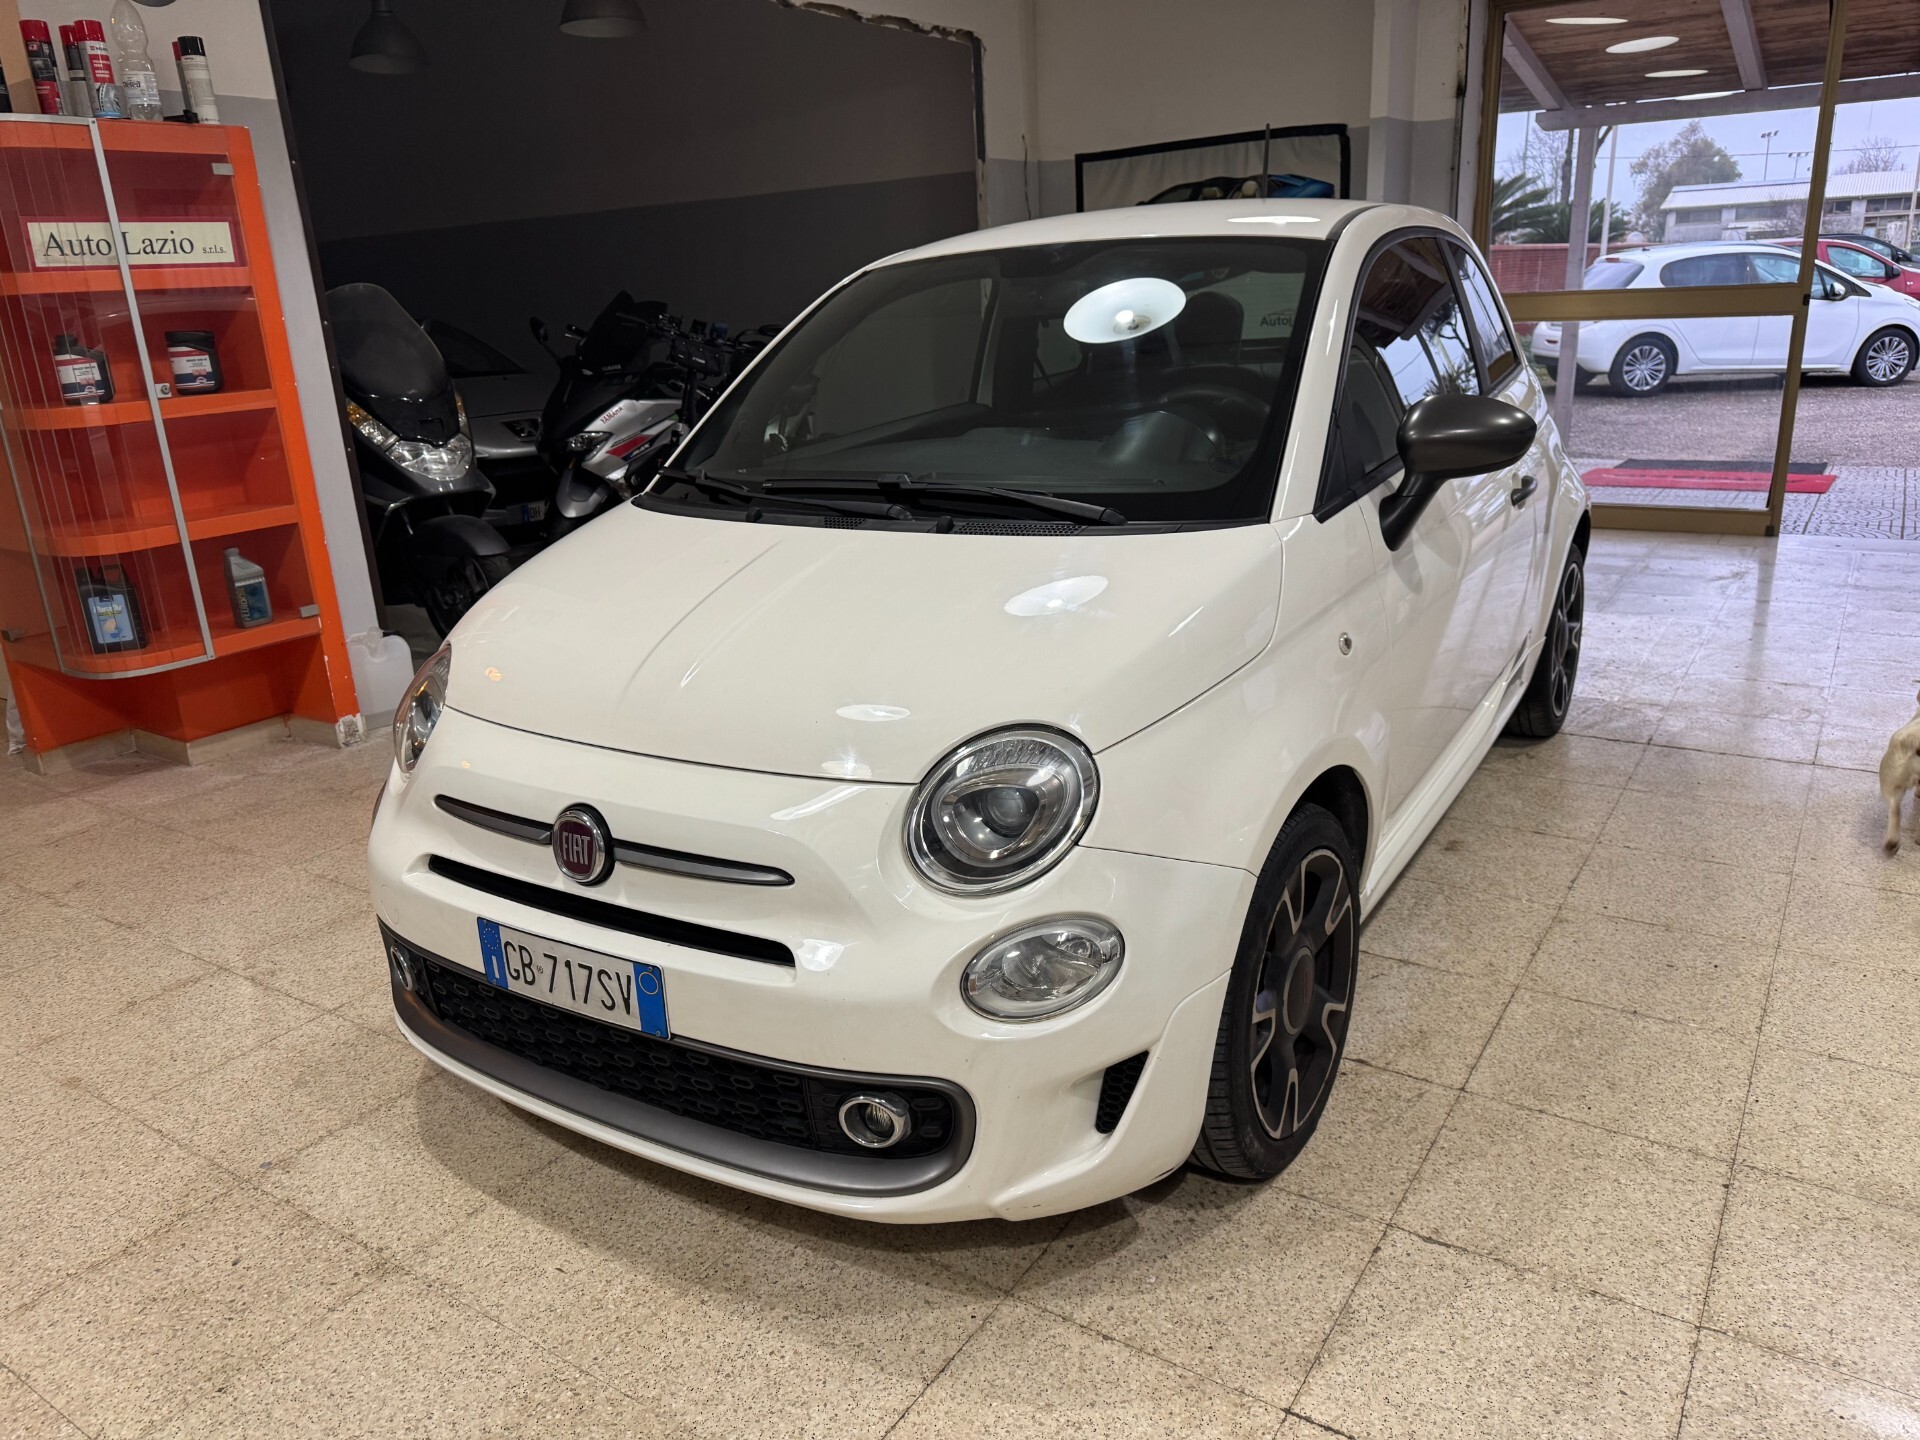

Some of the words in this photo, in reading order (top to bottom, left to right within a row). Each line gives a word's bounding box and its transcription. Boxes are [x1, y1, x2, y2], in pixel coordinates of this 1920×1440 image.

[43, 232, 112, 257] Auto
[120, 230, 195, 255] Lazio
[600, 406, 624, 425] YAMAHA
[562, 831, 591, 866] FIAT
